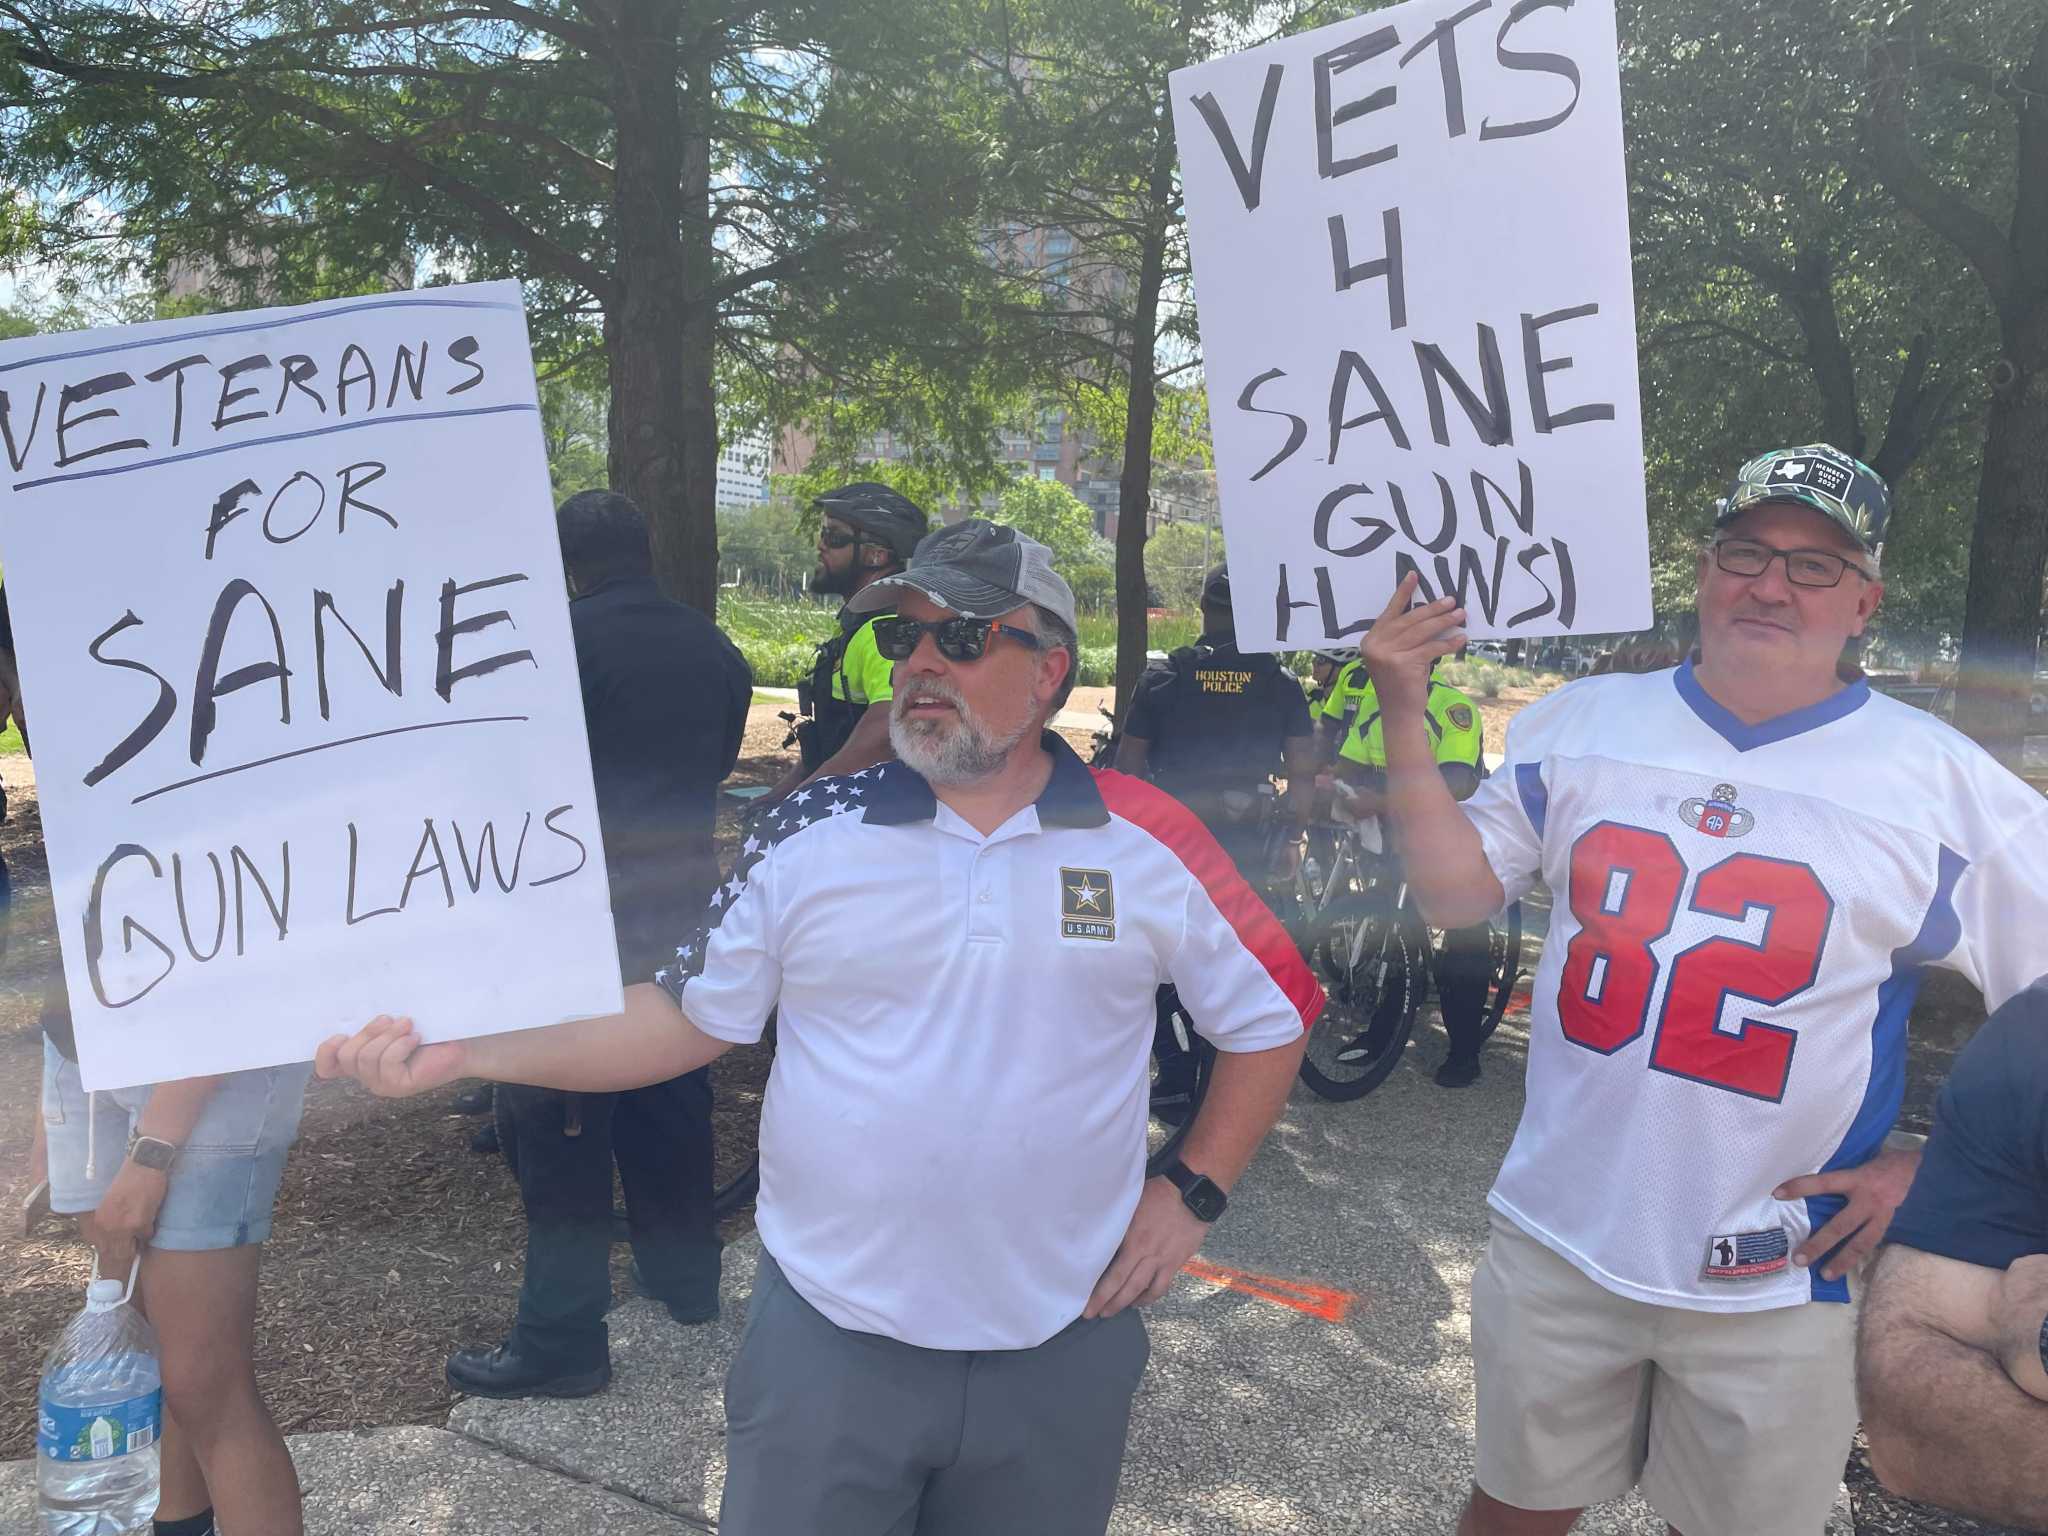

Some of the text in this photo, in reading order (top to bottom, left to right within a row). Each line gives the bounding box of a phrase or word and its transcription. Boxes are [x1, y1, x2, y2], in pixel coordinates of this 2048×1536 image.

[1190, 0, 1580, 213] VETS
[1328, 207, 1406, 329] 4
[0, 335, 484, 473] VETERANS
[1237, 303, 1615, 481] SANE
[205, 461, 399, 560] FOR
[1314, 459, 1533, 557] GUN
[83, 573, 538, 787] SANE
[1195, 670, 1252, 683] HOUSTON
[1203, 680, 1243, 693] POLICE
[82, 805, 587, 1009] GUN LAWS
[1085, 925, 1109, 937] ARMY
[1557, 819, 1835, 1104] 82
